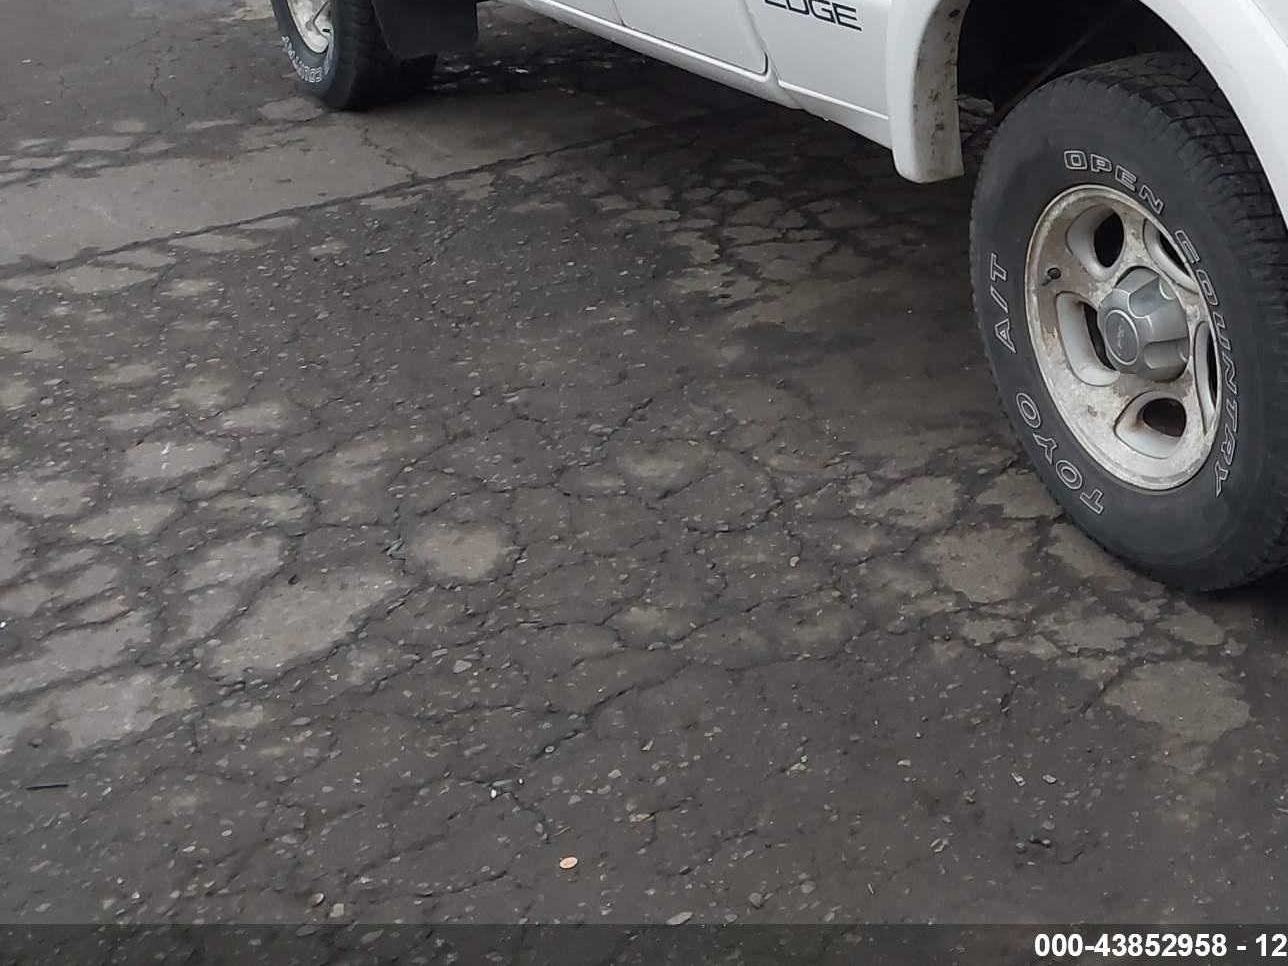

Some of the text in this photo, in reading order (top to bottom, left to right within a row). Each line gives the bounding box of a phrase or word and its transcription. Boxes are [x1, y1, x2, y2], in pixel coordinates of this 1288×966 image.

[989, 252, 1017, 353] A/T
[1063, 149, 1239, 497] OPEN COUNTRY
[1016, 391, 1105, 514] TOYO
